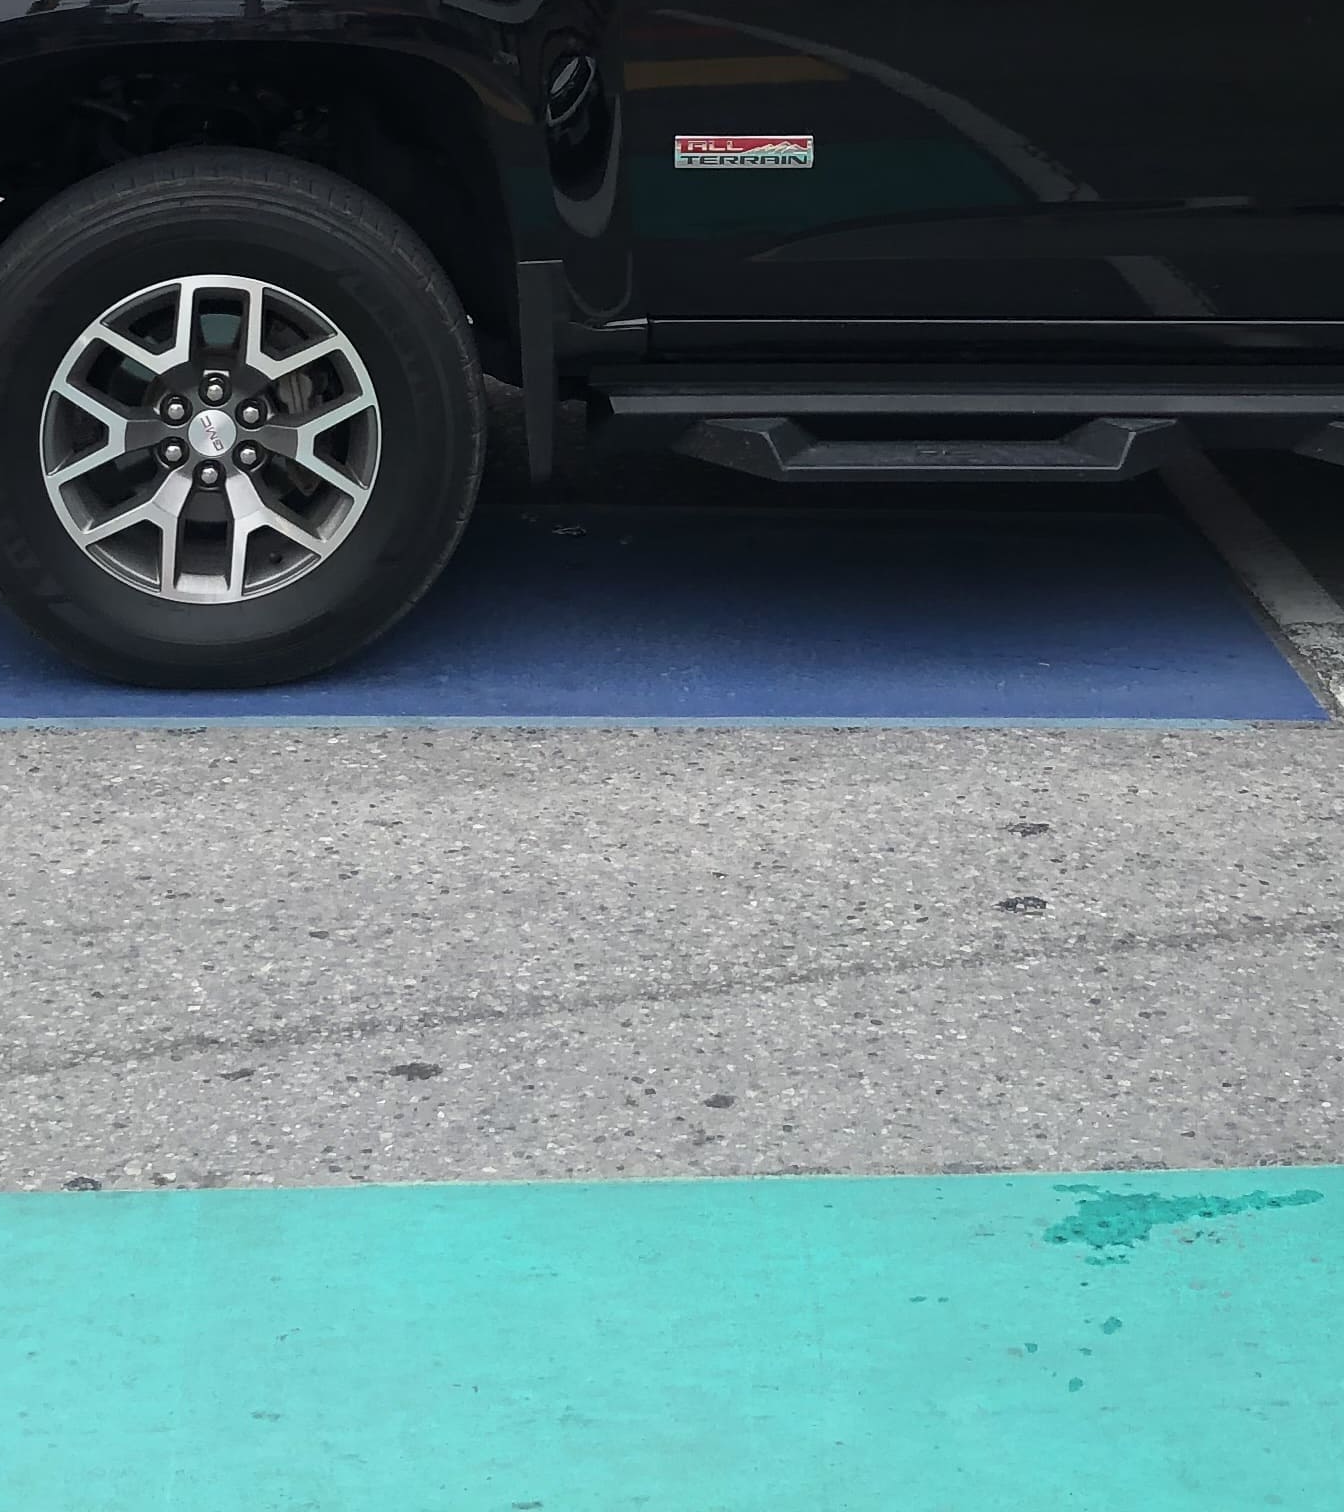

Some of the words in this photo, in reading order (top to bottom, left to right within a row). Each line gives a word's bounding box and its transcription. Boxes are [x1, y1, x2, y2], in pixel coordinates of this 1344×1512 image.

[687, 140, 743, 151] ALL
[679, 155, 808, 165] TERRAIN
[200, 415, 224, 451] GMC
